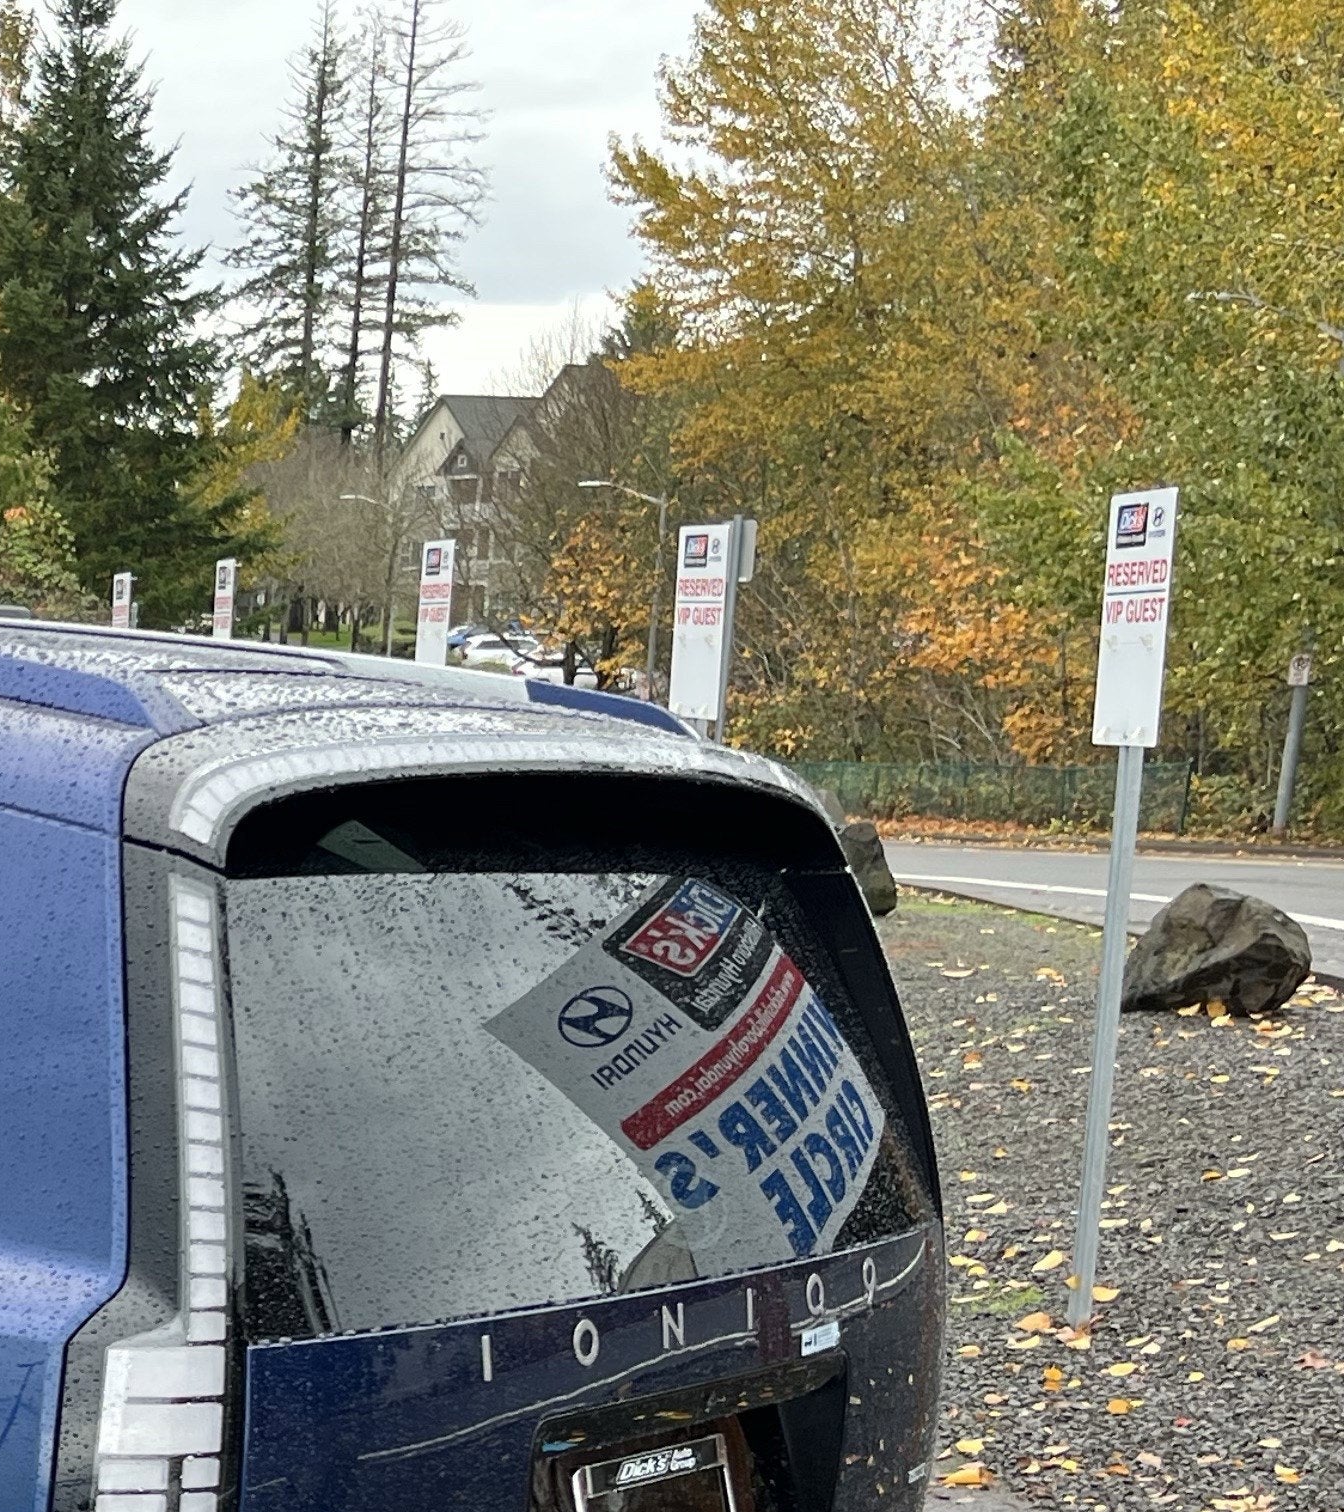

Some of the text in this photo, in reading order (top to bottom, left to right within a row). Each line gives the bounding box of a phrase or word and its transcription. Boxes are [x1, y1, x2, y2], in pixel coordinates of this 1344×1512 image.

[1107, 559, 1168, 587] RESERVED
[1106, 597, 1165, 624] VIP GUEST
[619, 1454, 668, 1481] Dick's
